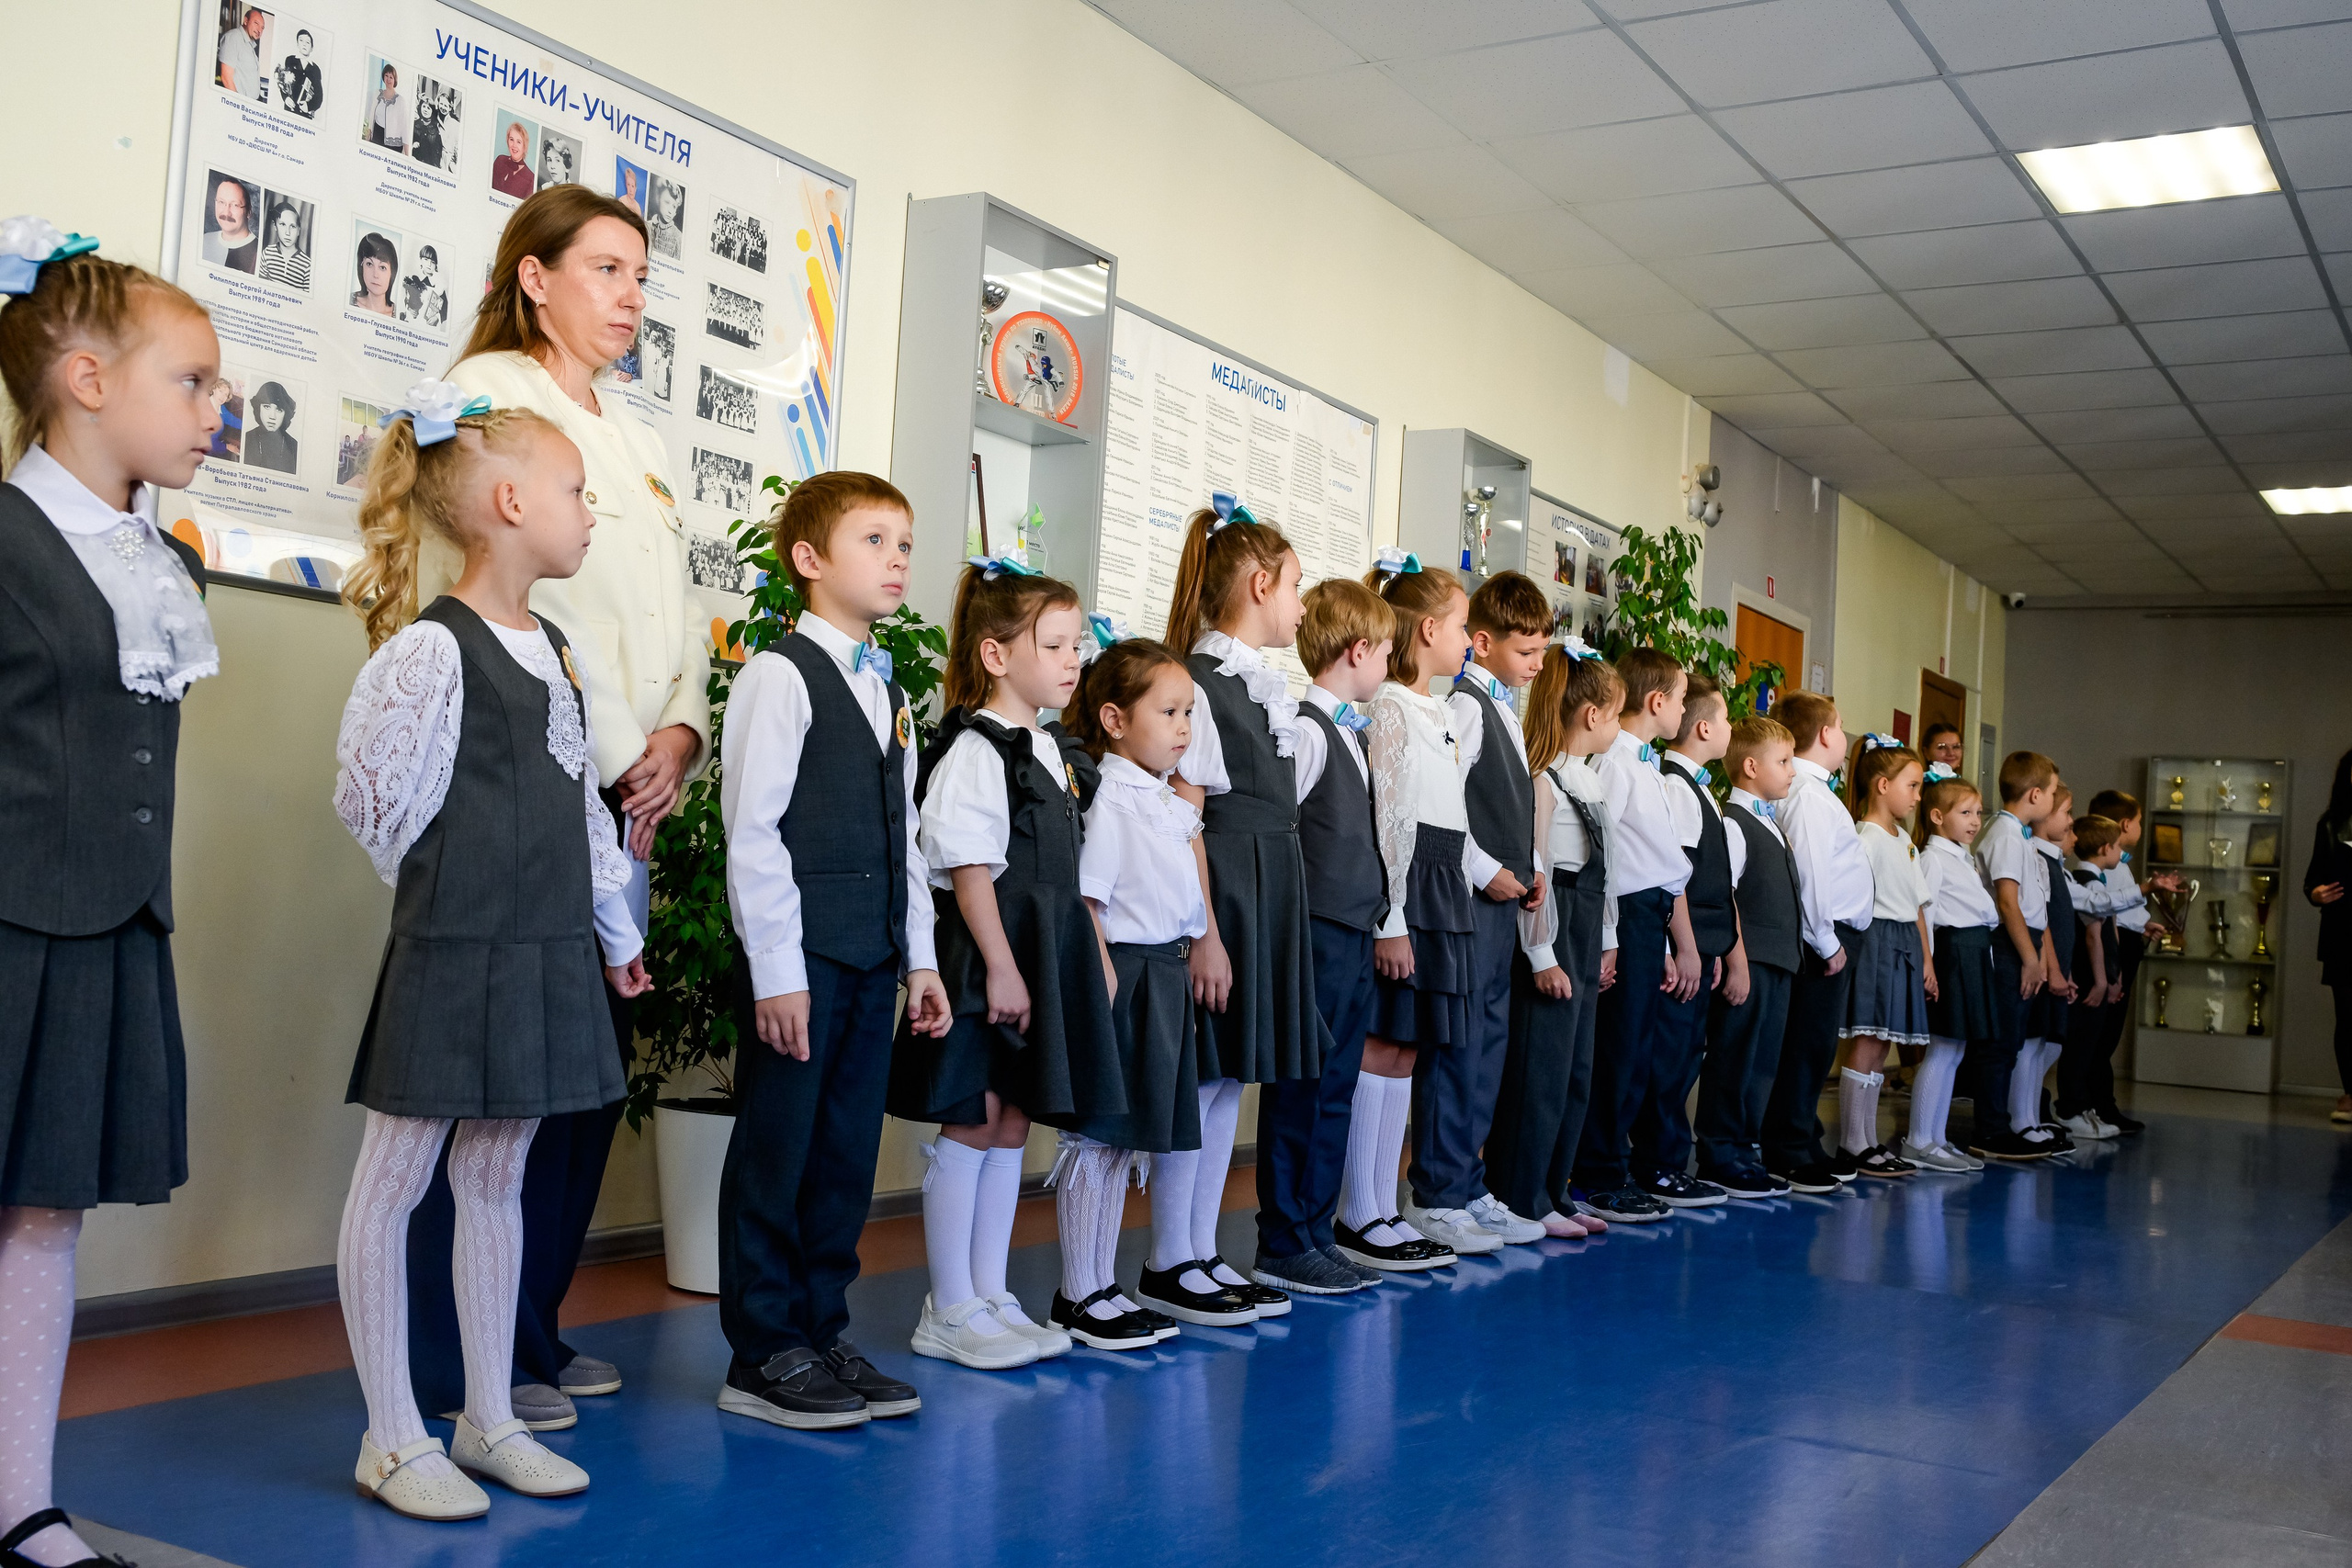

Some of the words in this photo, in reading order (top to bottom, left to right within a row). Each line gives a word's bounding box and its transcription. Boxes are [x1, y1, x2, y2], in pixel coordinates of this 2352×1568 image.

[435, 28, 691, 168] УЧЕНИКИ-УЧИТЕЛЯ
[220, 96, 240, 109] Попов
[241, 105, 267, 119] Василий
[268, 115, 316, 136] Александрович
[242, 114, 265, 128] Выпуск
[266, 122, 278, 132] 1988
[280, 129, 294, 138] года
[228, 134, 238, 142] МБУ
[286, 155, 304, 165] Самара
[254, 137, 277, 149] Директор
[387, 166, 406, 179] Выпуск
[407, 175, 418, 183] 1982
[418, 179, 430, 187] года
[407, 166, 423, 176] Ирина
[424, 172, 456, 188] Михайловна
[389, 192, 404, 201] Школы
[422, 202, 436, 212] Самара
[489, 196, 517, 209] Власова-П
[209, 273, 239, 288] Филиппов
[240, 282, 262, 294] Сергей
[263, 289, 302, 305] Анатольевич
[229, 288, 251, 301] Выпуск
[252, 295, 265, 304] 1989
[266, 299, 280, 308] года
[217, 303, 242, 314] директора
[230, 315, 250, 323] истории
[254, 321, 294, 335] обществознания
[244, 325, 274, 338] бюджетного
[275, 333, 302, 345] нетипового
[344, 312, 391, 332] Егорова-Глухова
[392, 326, 408, 336] Елена
[408, 331, 448, 348] Владимировна
[242, 333, 270, 344] учреждения
[271, 340, 297, 351] Самарской
[298, 347, 317, 355] области
[375, 330, 395, 341] Выпуск
[407, 340, 418, 348] года
[274, 348, 300, 359] одаренных
[364, 344, 381, 353] Учитель
[382, 349, 404, 359] географии
[408, 355, 426, 366] биологии
[364, 351, 377, 359] МБОУ
[411, 364, 424, 372] Самара
[1069, 381, 1079, 400] 2018
[1212, 362, 1285, 412] МЕДАЛИСТЫ
[627, 399, 642, 408] Выпуск
[214, 477, 237, 489] Выпуск
[238, 481, 252, 490] 1982
[253, 485, 266, 493] года
[238, 472, 264, 484] Татьяна
[265, 478, 309, 492] Станиславовна
[1332, 480, 1352, 493] ОТЛИЧИЕМ
[184, 489, 204, 497] Учитель
[200, 500, 216, 508] регент
[1149, 507, 1182, 523] СЕРЕБРЯНЫЕ
[1149, 517, 1180, 532] МЕДАЛИСТЫ
[1589, 530, 1611, 550] ДАТАХ
